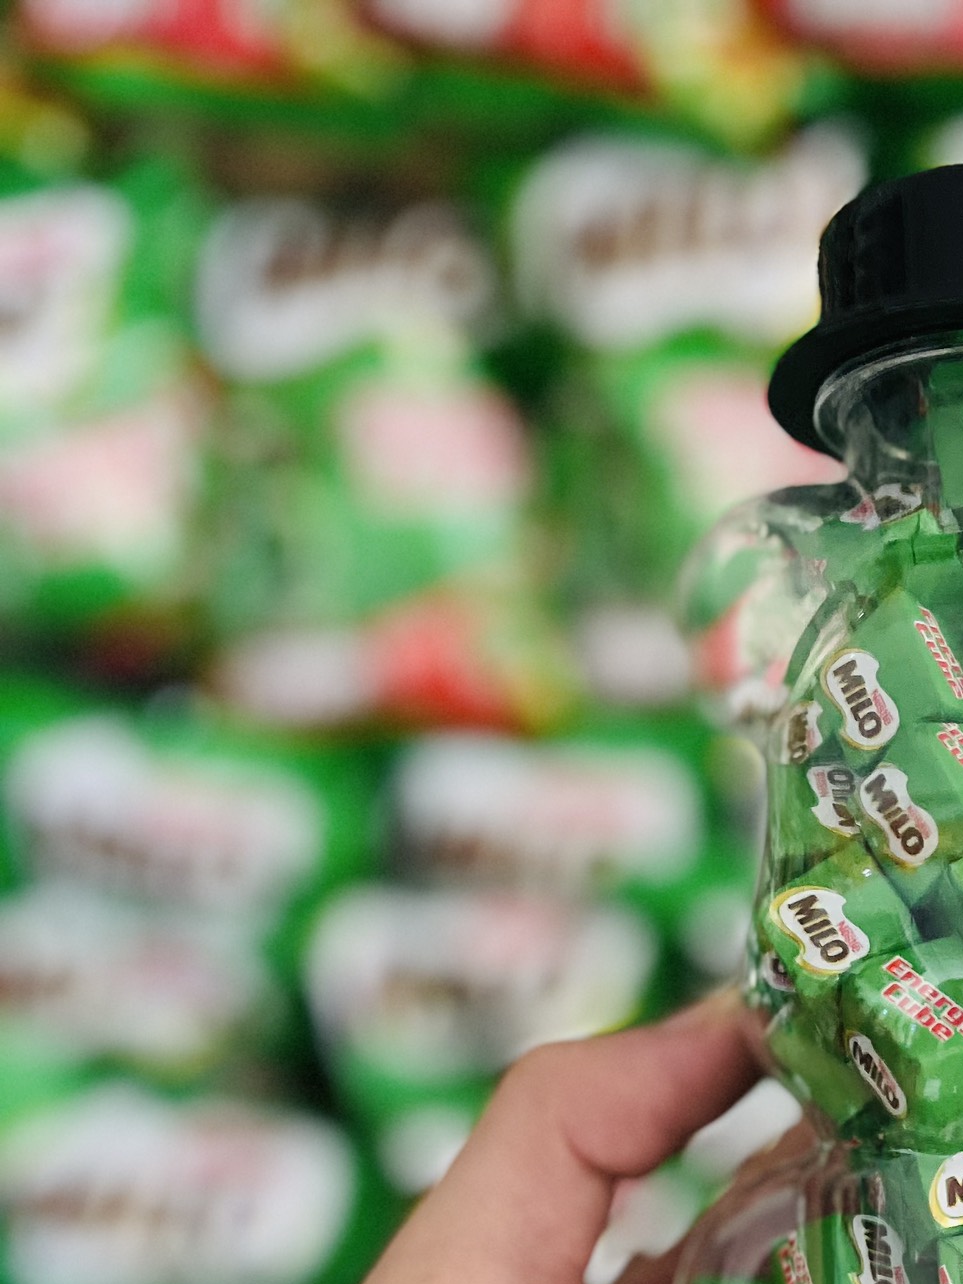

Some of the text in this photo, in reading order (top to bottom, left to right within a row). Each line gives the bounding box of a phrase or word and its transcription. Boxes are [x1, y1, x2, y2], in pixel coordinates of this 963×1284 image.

[833, 659, 882, 739] MILO
[864, 774, 925, 856] MILO
[787, 894, 850, 964] MILO
[881, 980, 955, 1043] Cube
[852, 1040, 900, 1110] MILO
